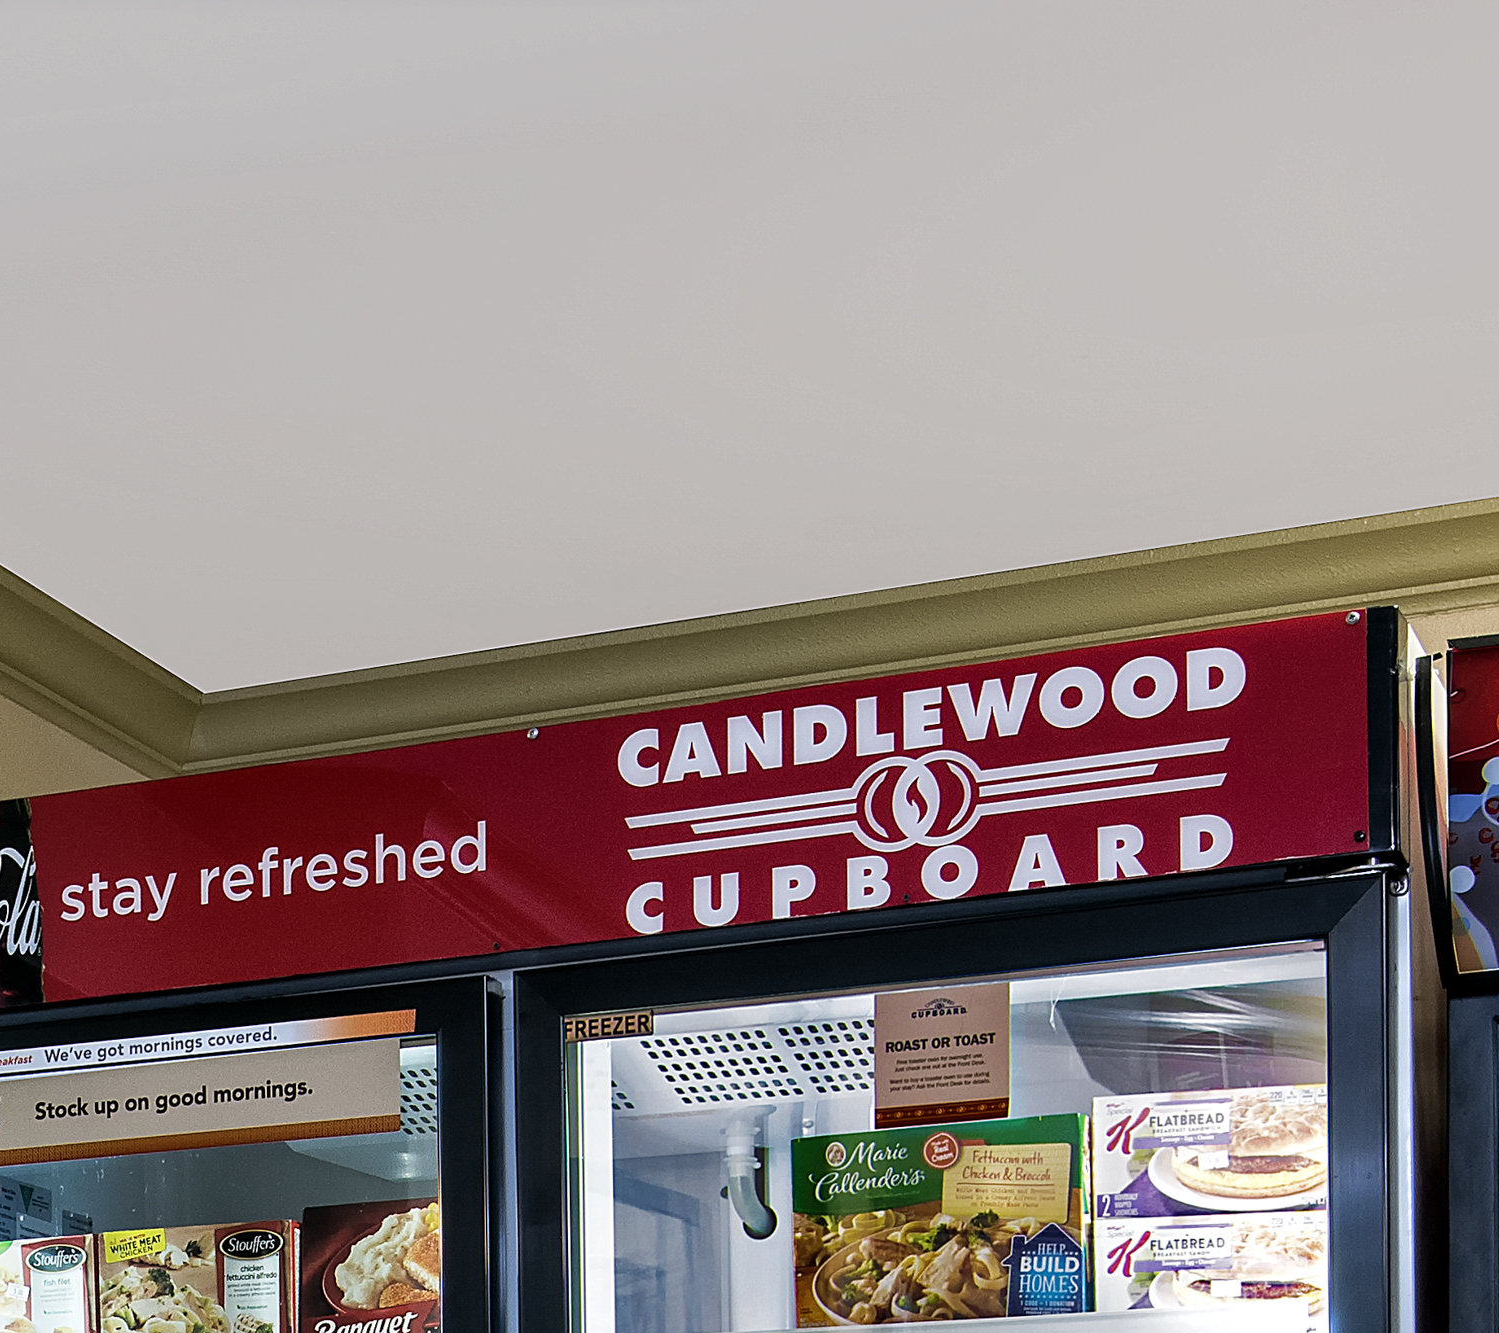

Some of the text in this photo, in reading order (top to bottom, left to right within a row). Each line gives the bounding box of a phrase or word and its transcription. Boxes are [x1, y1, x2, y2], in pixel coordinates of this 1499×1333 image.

[618, 646, 1246, 787] CANDLEWOOD
[60, 820, 487, 922] stay refreshed
[626, 814, 1234, 935] CUPBOARD
[565, 1014, 651, 1039] FREEZER
[44, 1048, 92, 1063] We've
[98, 1046, 124, 1063] got
[129, 1037, 203, 1057] mornings
[208, 1028, 278, 1049] covered.
[885, 1033, 996, 1053] ROAST OR TOAST
[35, 1079, 313, 1120] Stock up on good mornings.
[1149, 1112, 1224, 1127] FLATBREAD
[110, 1235, 162, 1254] WHITE MEAT
[228, 1234, 275, 1254] Stouffer's
[1037, 1243, 1066, 1255] HELP
[1150, 1238, 1225, 1250] FLATBREAD
[1020, 1256, 1080, 1273] BUILD
[1018, 1274, 1078, 1294] HOMES
